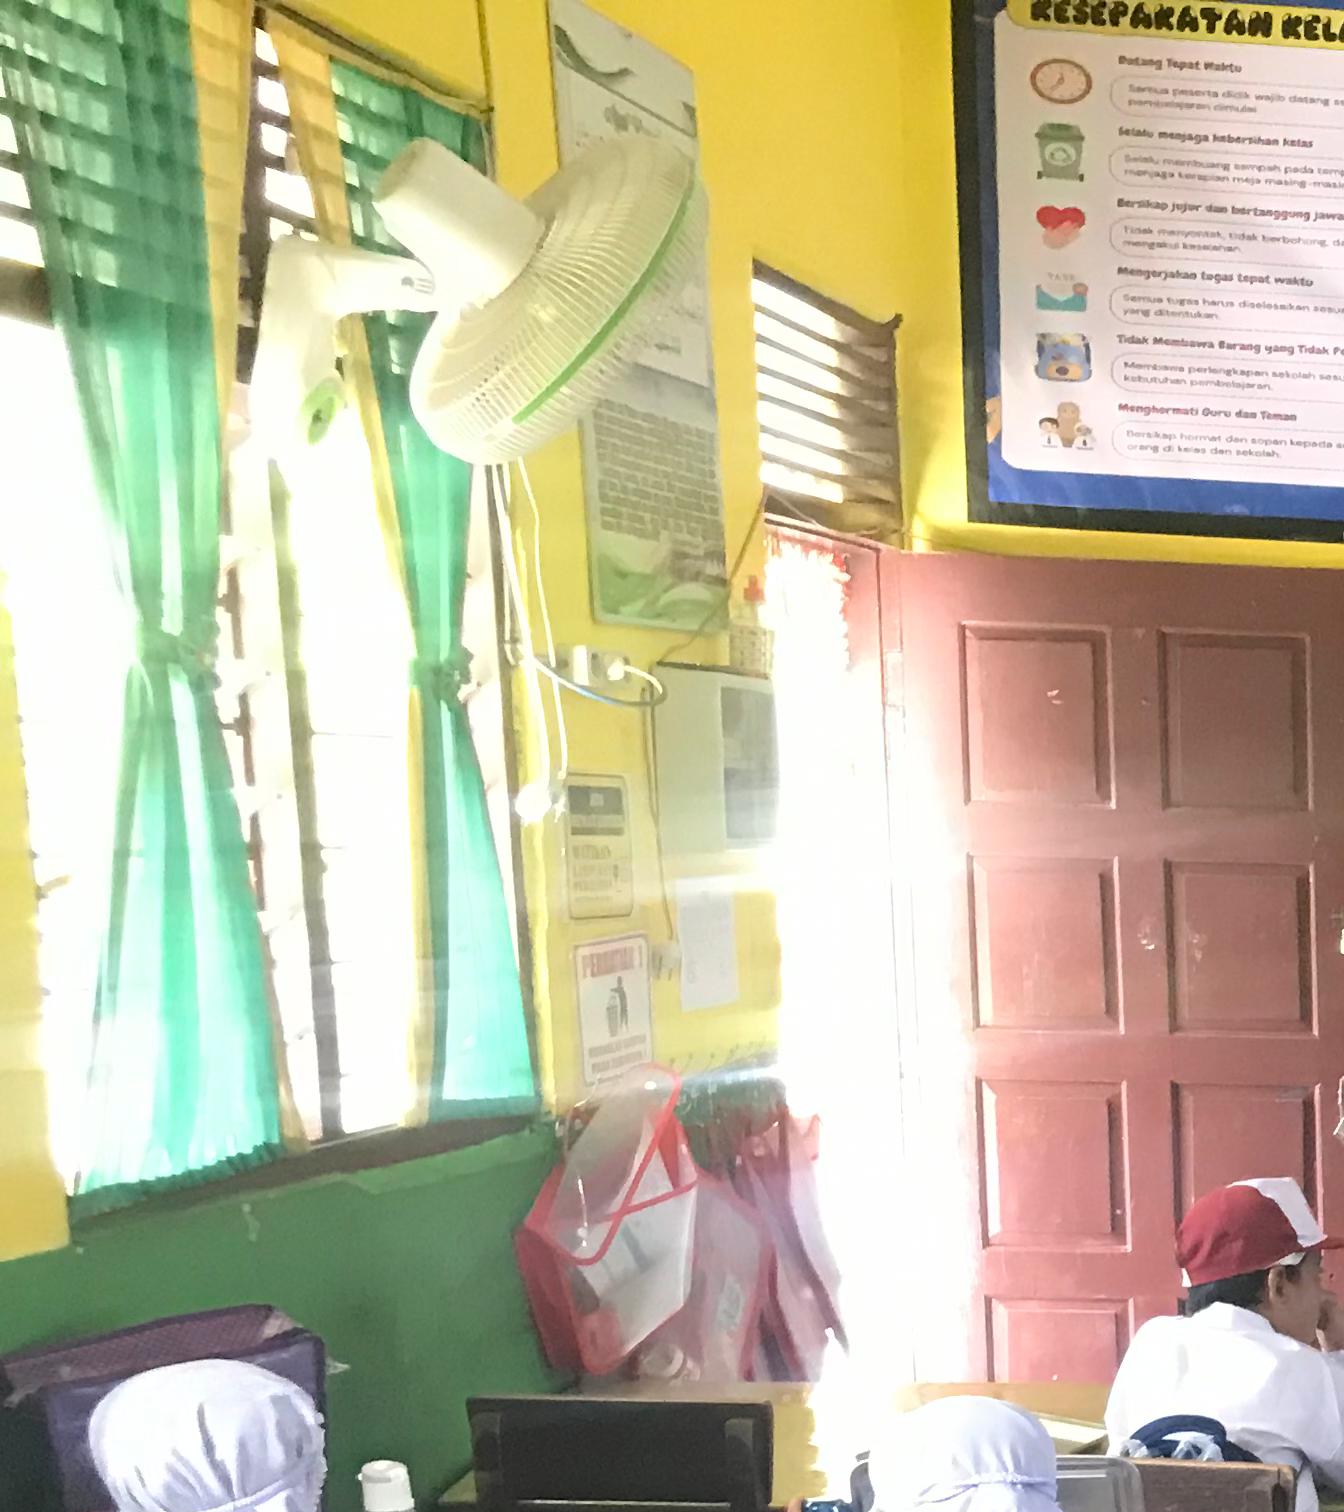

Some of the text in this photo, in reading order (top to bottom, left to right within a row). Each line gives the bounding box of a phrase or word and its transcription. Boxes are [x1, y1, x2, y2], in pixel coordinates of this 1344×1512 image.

[1030, 0, 1273, 39] KESEPAKATAN
[1118, 55, 1162, 68] Datang
[1167, 58, 1200, 71] Tepat
[1159, 131, 1209, 145] menjaga
[1213, 134, 1279, 146] kebersihan
[1283, 137, 1313, 148] kelas
[1118, 198, 1167, 211] Bersikap
[1171, 202, 1202, 212] jujur
[1206, 204, 1227, 213] dan
[1232, 206, 1310, 221] bertanggung
[1117, 265, 1313, 287] Mengerjakan tugas tepat waktu
[1117, 333, 1149, 347] Tidak
[1153, 336, 1214, 349] Membawa
[1219, 339, 1261, 354] Barang
[1265, 344, 1293, 357] yang
[1297, 343, 1328, 356] Tidak
[1118, 403, 1297, 421] Menghormati Guru dan Teman
